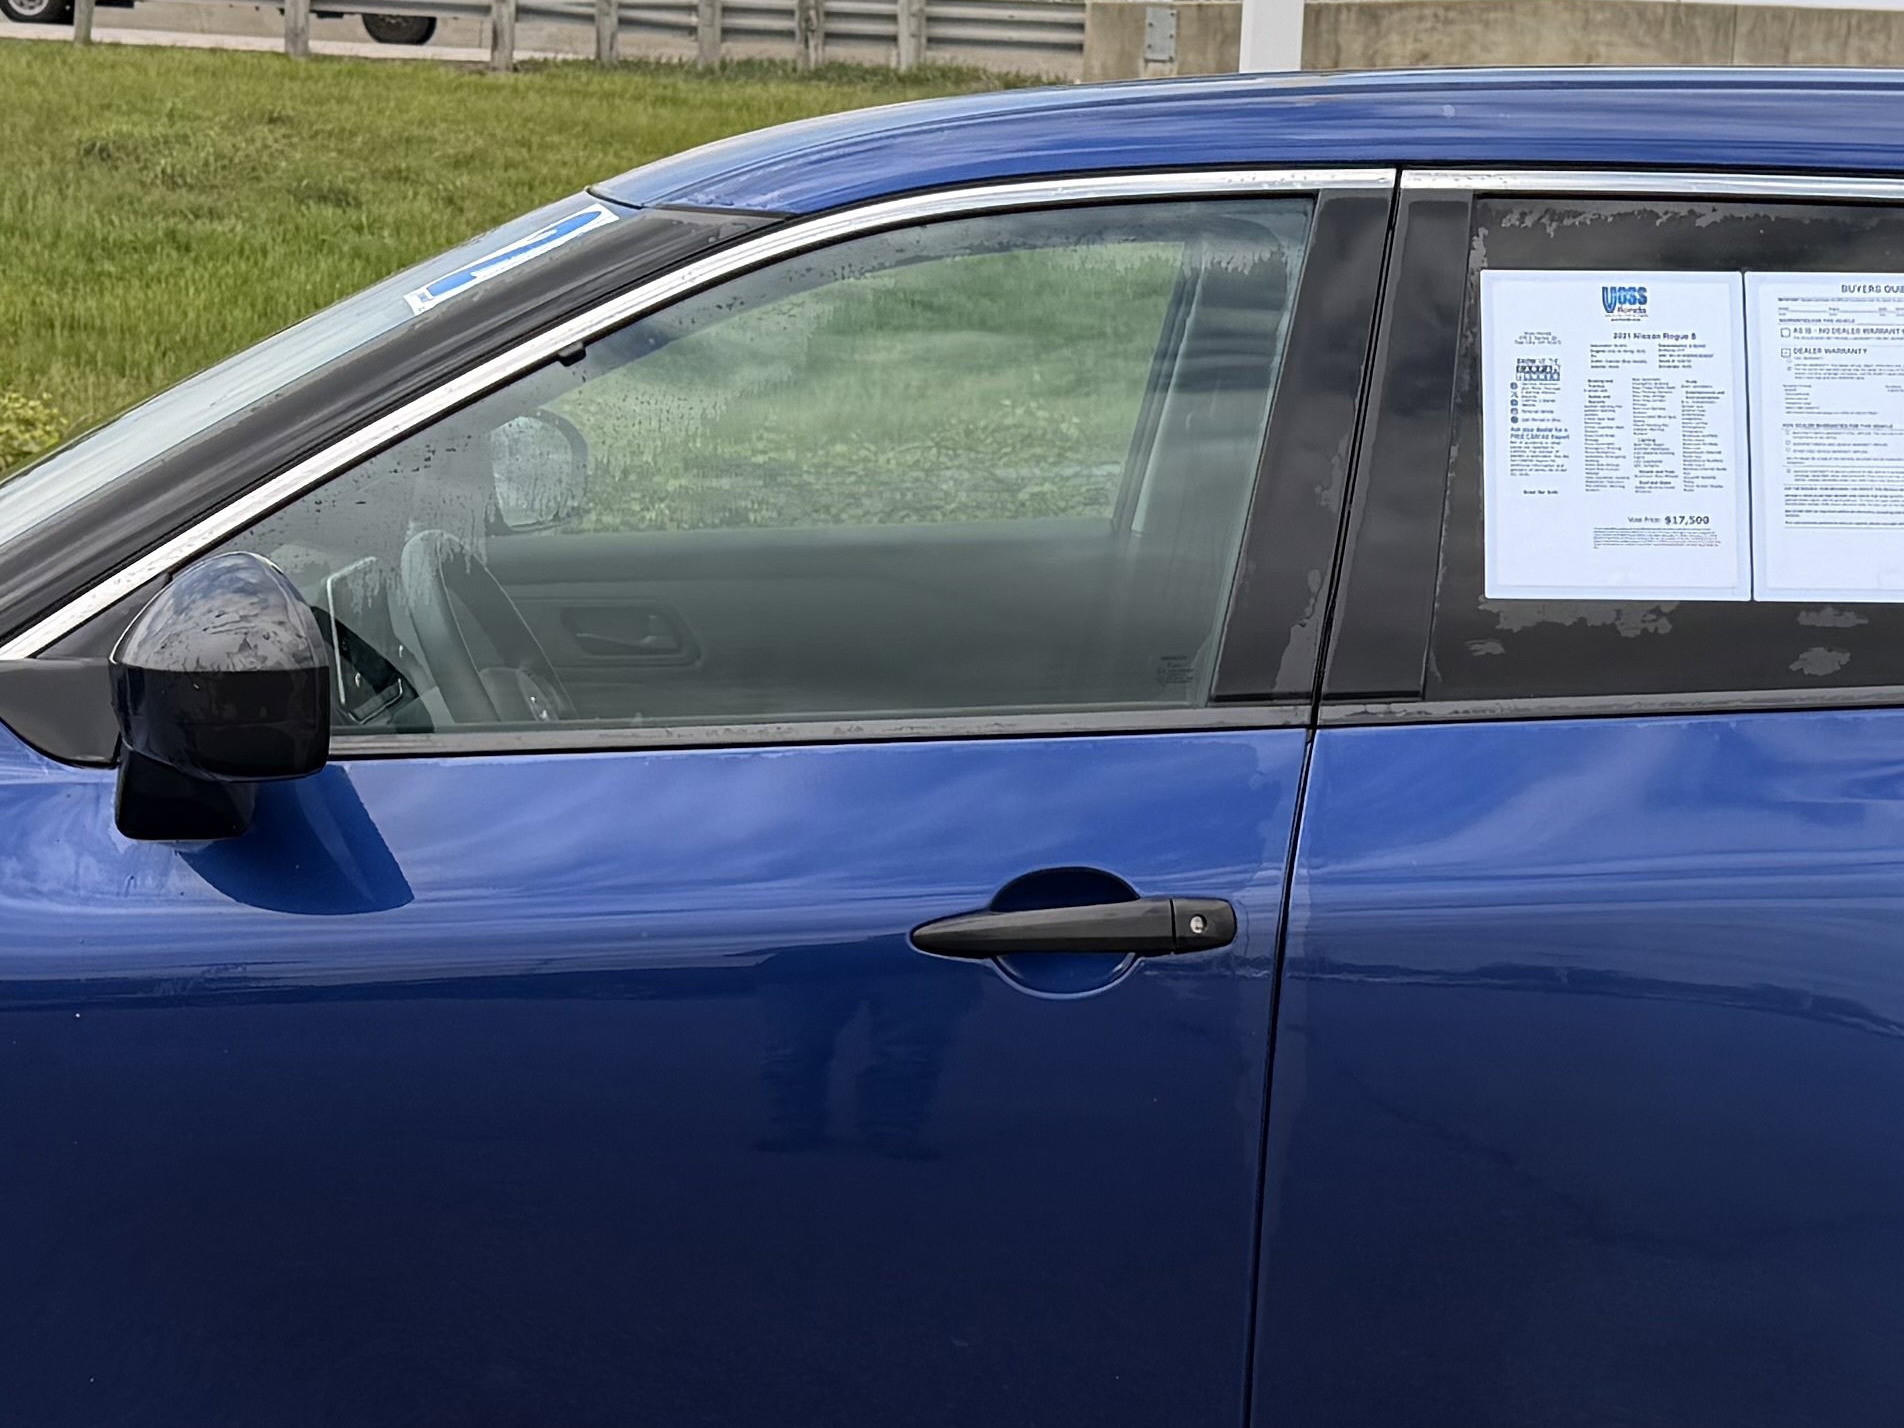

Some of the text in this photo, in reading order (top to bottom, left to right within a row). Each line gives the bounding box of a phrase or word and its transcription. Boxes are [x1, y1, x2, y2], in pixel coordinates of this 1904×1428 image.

[1841, 284, 1882, 294] BUYERS
[1602, 286, 1648, 314] VOSS
[1665, 515, 1710, 526] $17,500
